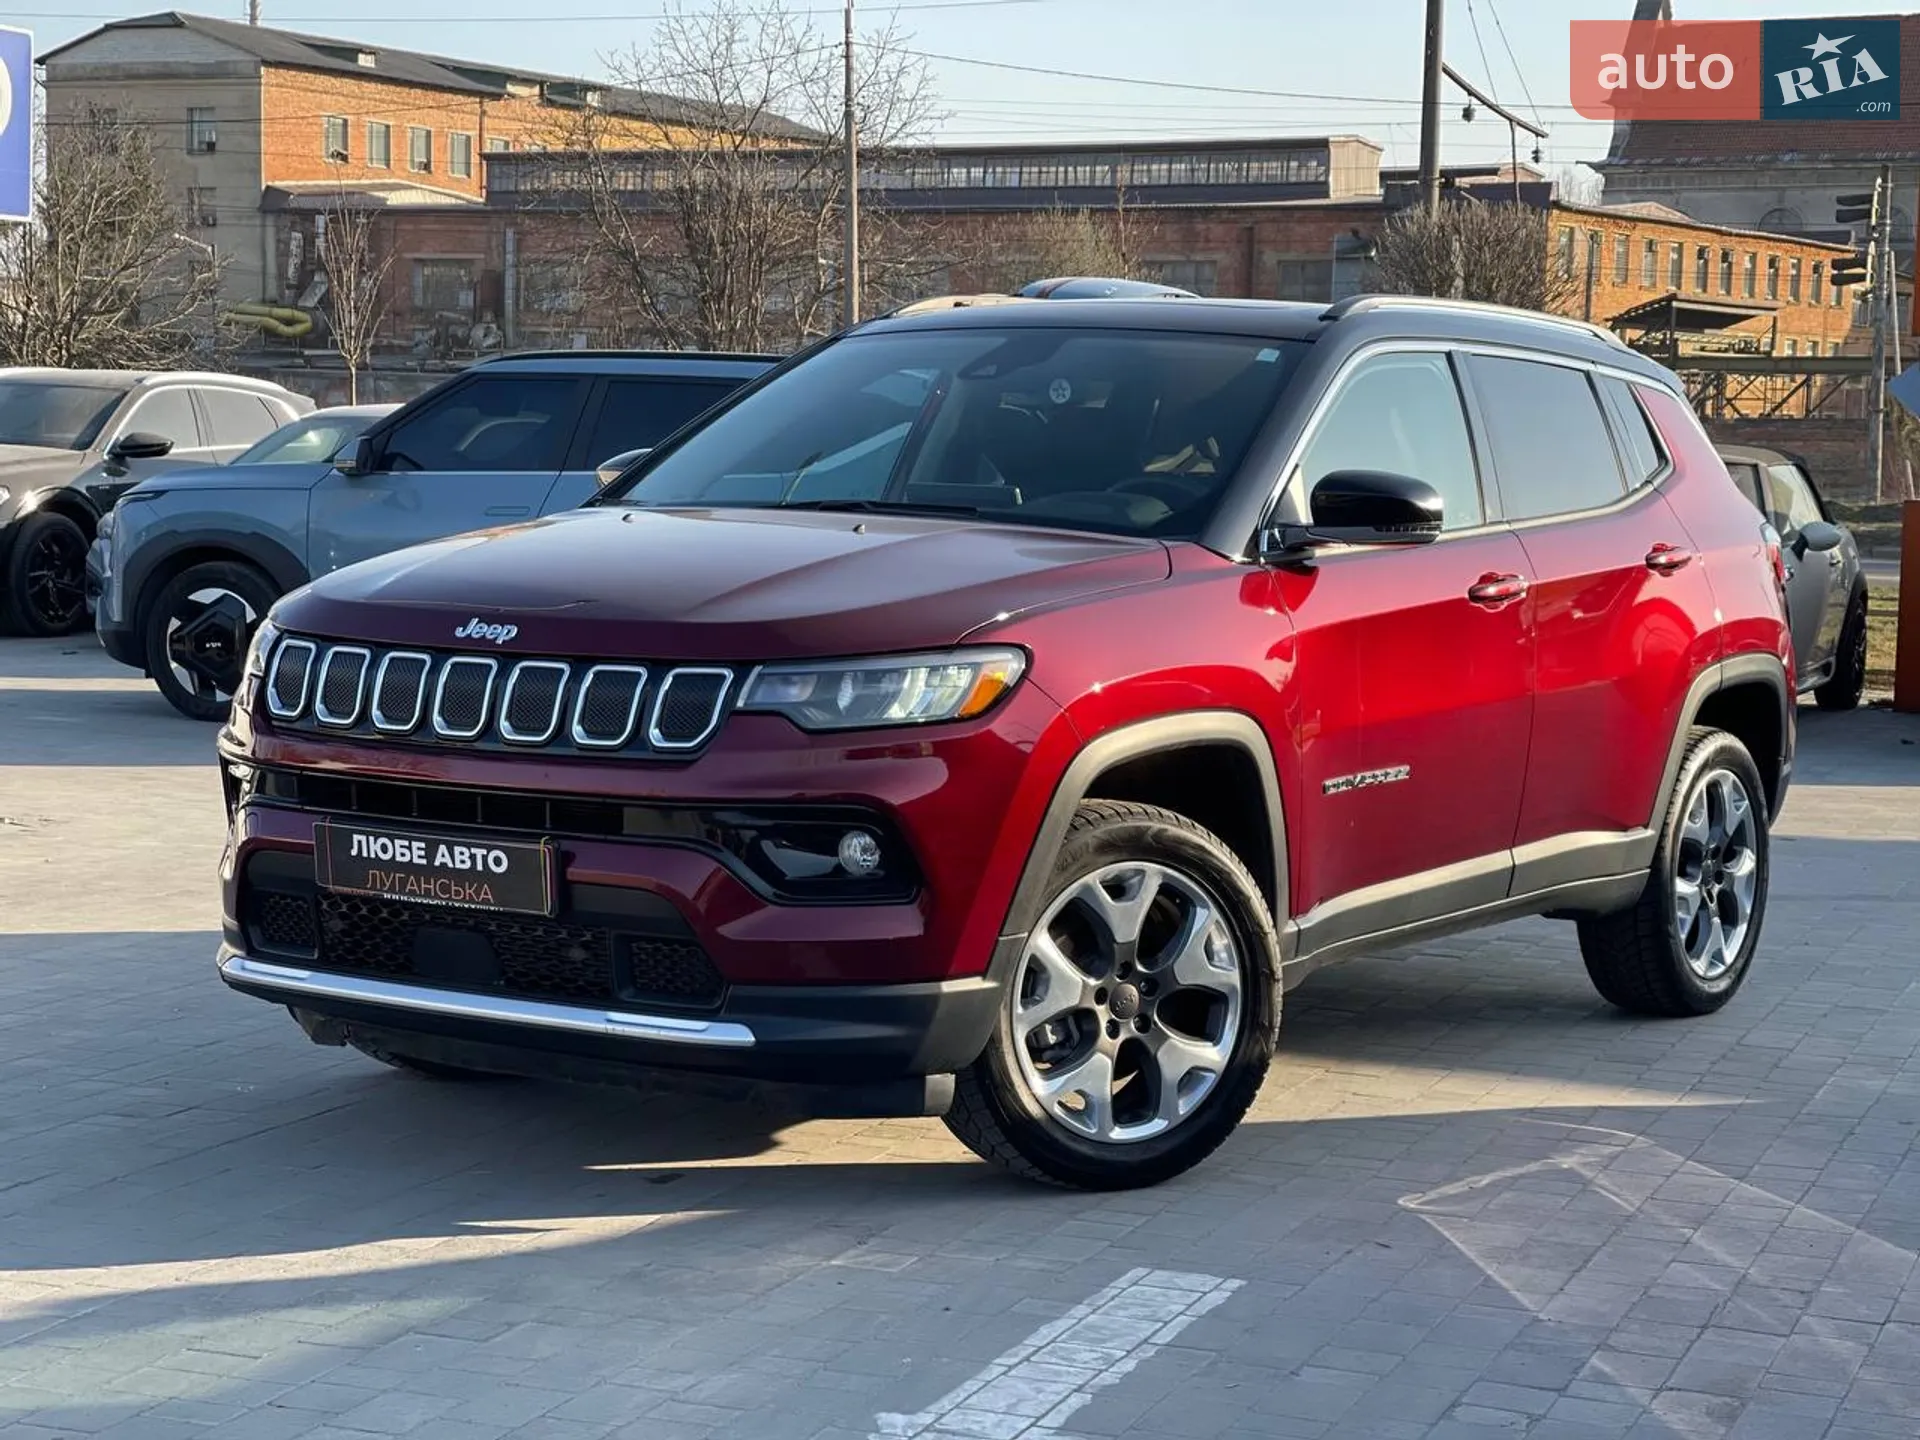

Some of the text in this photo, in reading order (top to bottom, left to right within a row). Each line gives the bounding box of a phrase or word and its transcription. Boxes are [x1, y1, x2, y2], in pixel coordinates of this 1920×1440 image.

[455, 617, 518, 644] Jeep
[350, 833, 509, 874] ЛЮБЕ АВТО
[366, 869, 494, 902] ЛУГАНСЬКА
